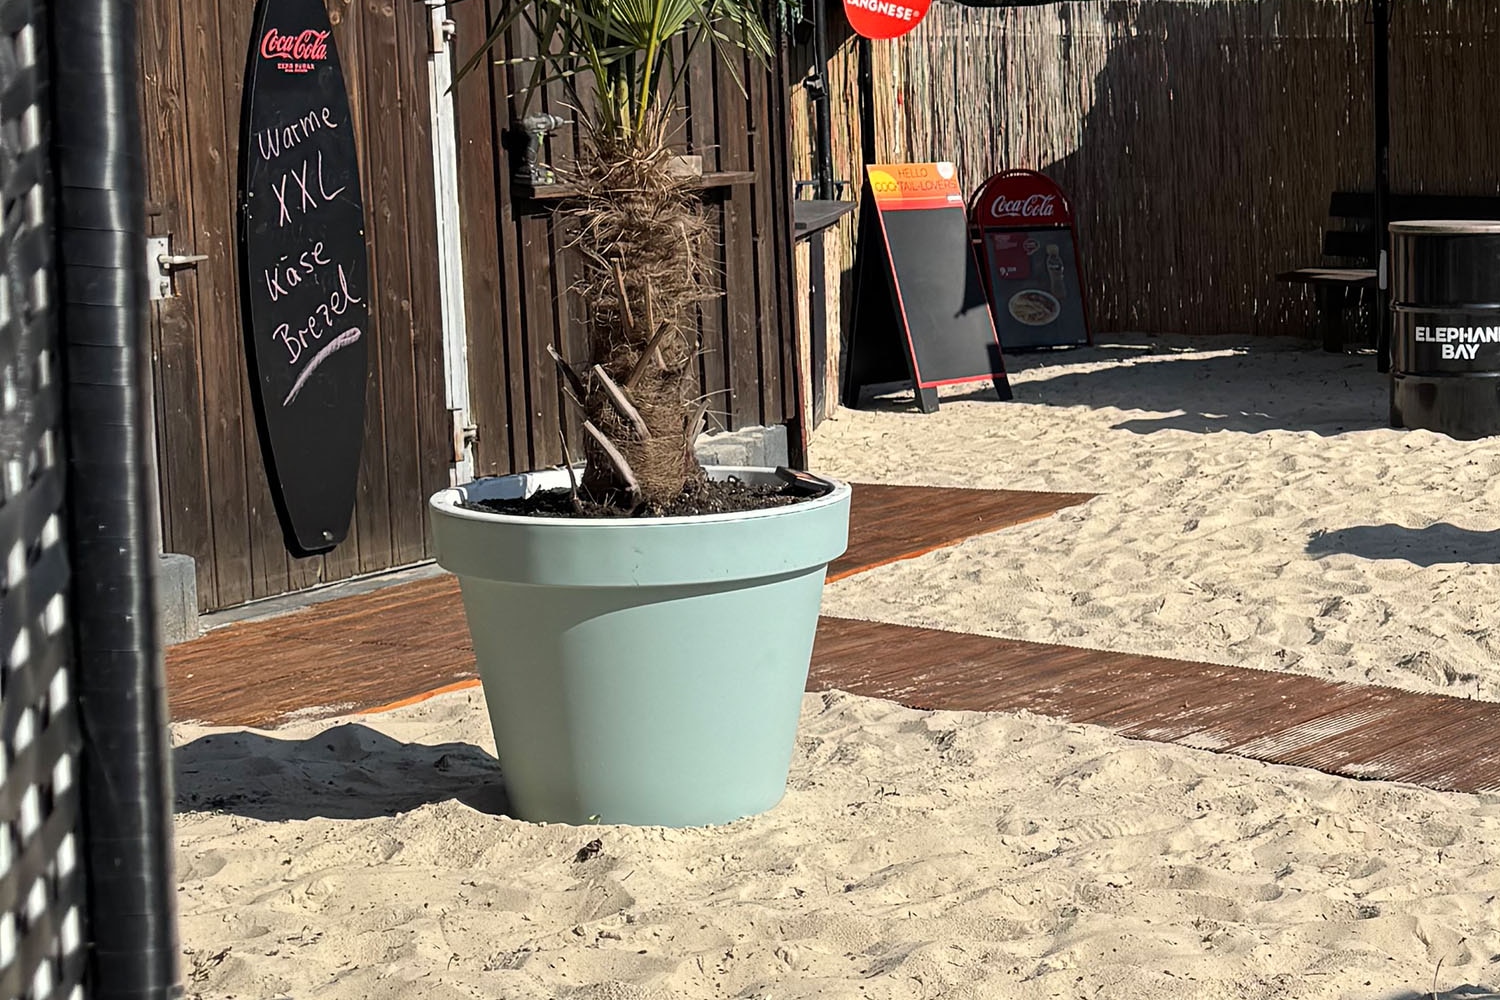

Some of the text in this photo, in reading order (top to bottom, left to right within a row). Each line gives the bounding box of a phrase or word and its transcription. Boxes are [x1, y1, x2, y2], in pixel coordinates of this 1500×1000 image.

[261, 28, 331, 60] Coca-Cola
[897, 167, 928, 179] HELLO
[272, 150, 346, 227] XXL
[991, 194, 1056, 218] Coca-Cola
[264, 241, 331, 302] Käse
[1441, 343, 1480, 360] BAY
